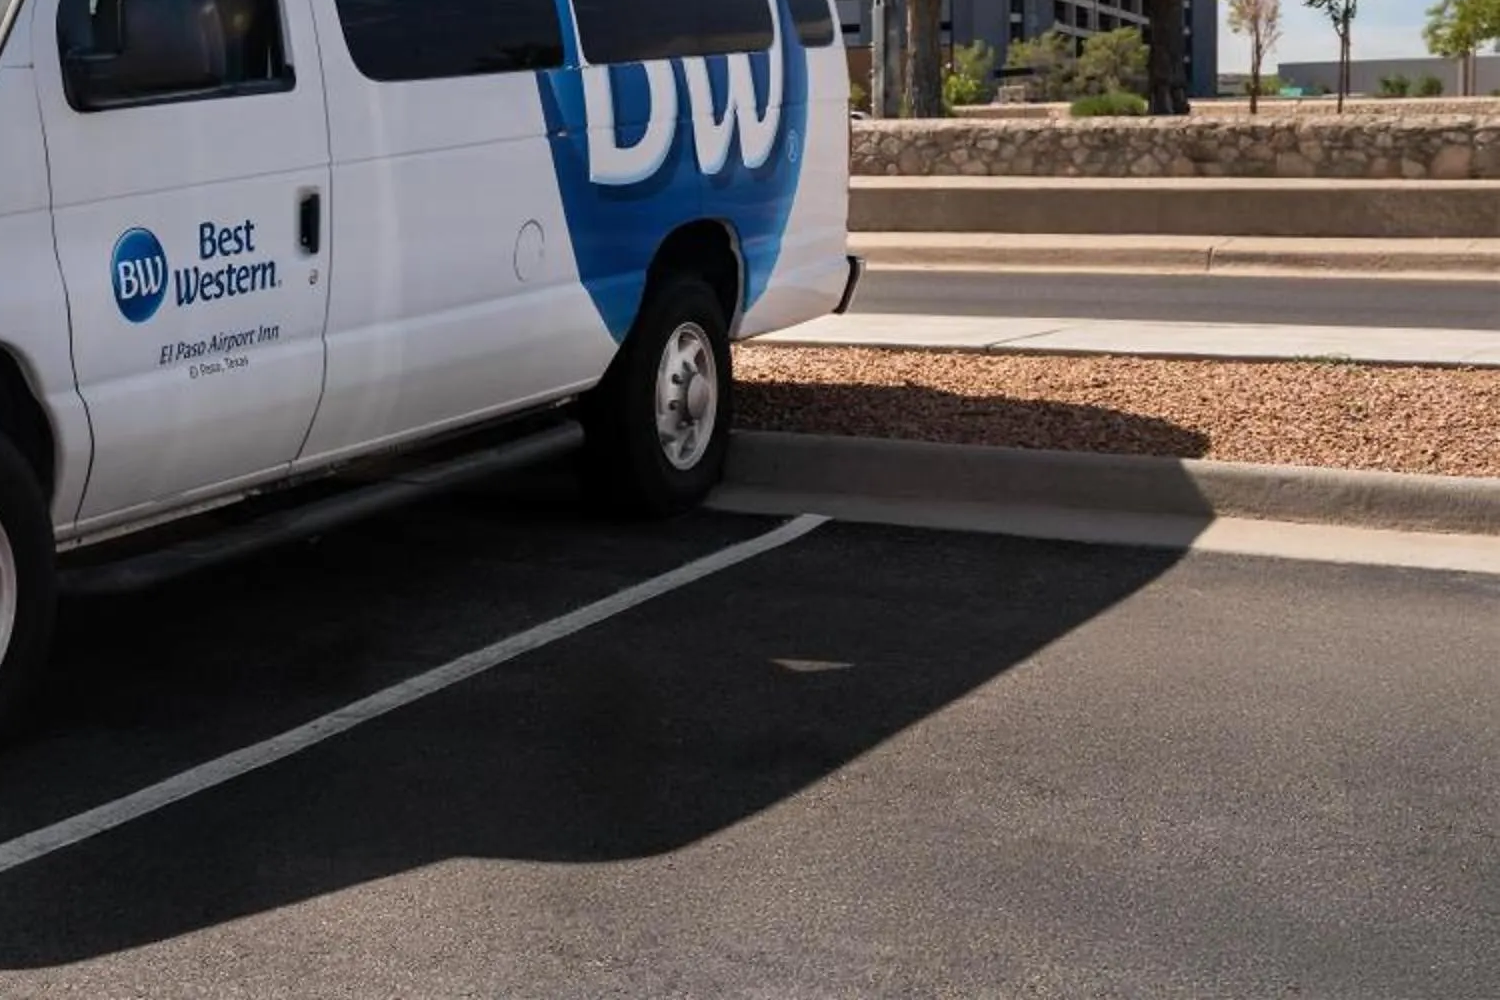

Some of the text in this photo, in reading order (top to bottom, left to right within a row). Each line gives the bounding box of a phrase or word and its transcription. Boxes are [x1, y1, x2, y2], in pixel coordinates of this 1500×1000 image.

[199, 219, 255, 261] Best
[118, 255, 164, 300] BW
[174, 260, 277, 307] Western
[159, 324, 280, 365] El Paso Airport Inn
[223, 355, 249, 369] Texas
